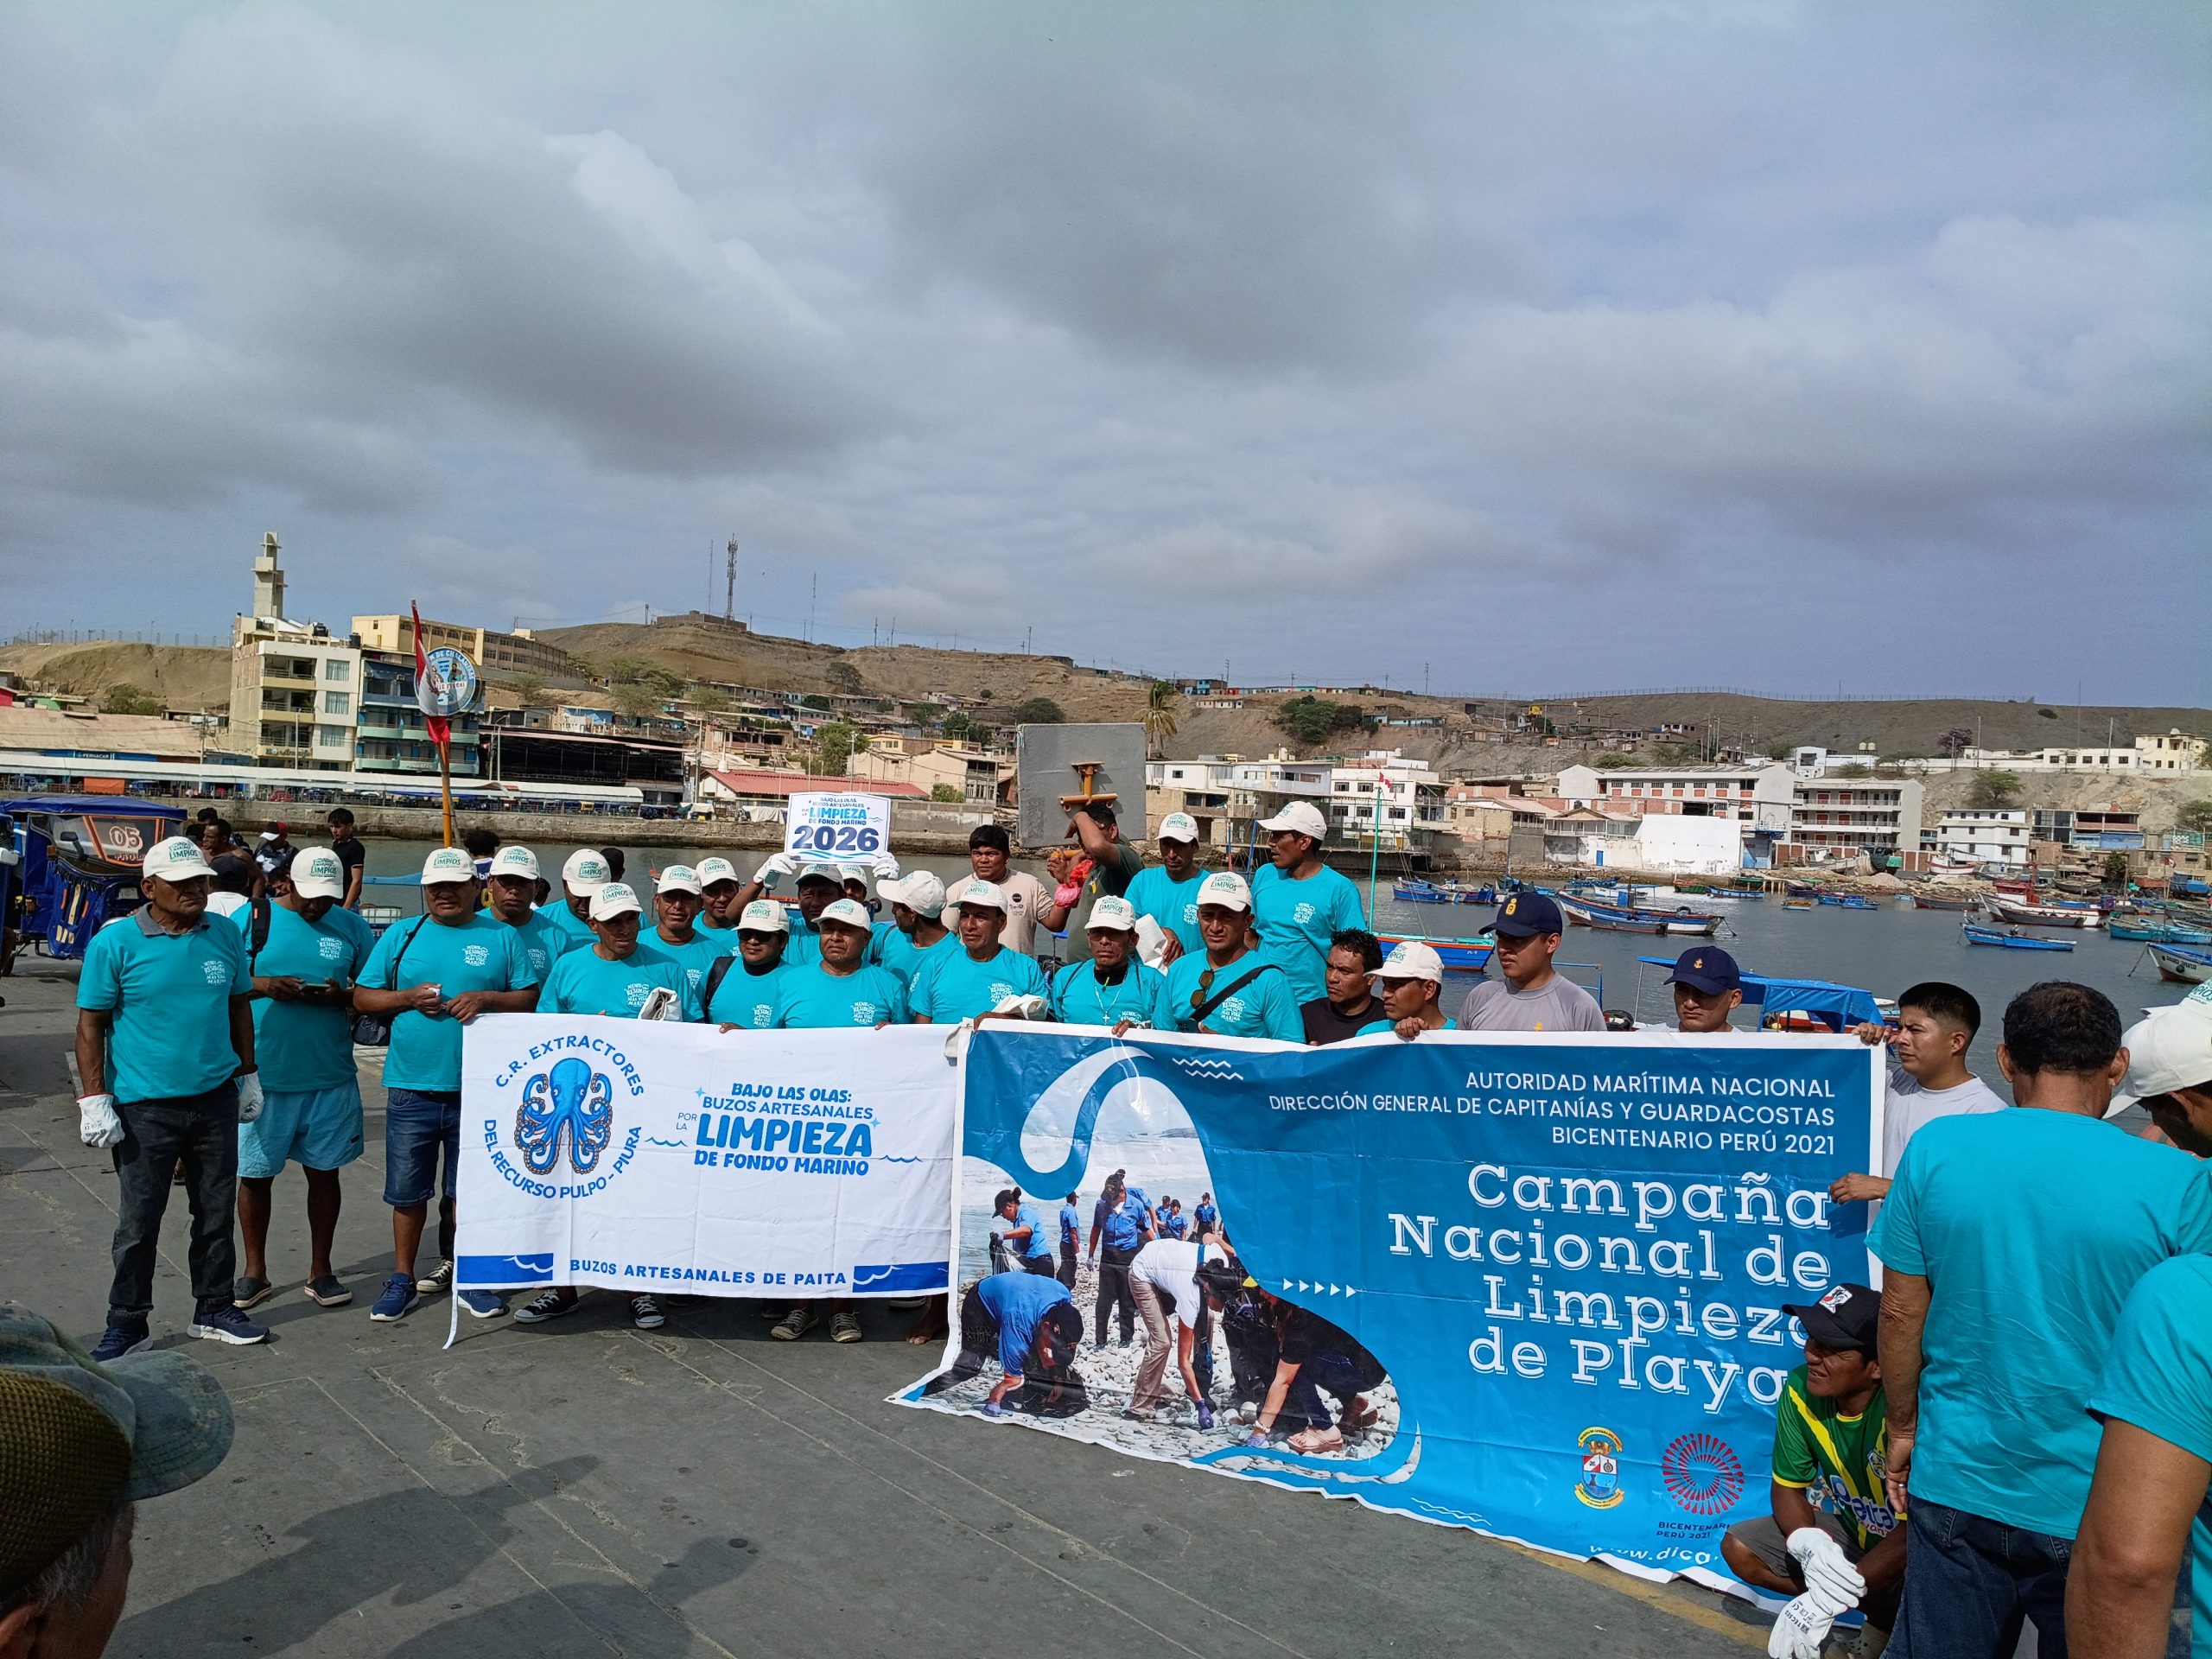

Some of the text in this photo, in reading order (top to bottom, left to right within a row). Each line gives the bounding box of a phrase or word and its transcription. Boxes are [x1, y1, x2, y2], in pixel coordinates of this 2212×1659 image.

[809, 807, 868, 820] LIMPIEZA
[109, 826, 143, 850] 05
[791, 824, 880, 852] 2026
[168, 849, 199, 860] LIMPIOS
[495, 1035, 645, 1096] C.R. EXTRACTORES
[731, 1082, 852, 1103] BAJO LAS OLAS:
[1466, 1071, 1835, 1097] AUTORIDAD MARÍTIMA NACIONAL
[702, 1096, 874, 1121] BUZOS ARTESANALES
[1268, 1091, 1834, 1126] DIRECCIÓN GENERAL DE CAPITANÍAS Y GUARDACOSTAS
[484, 1119, 499, 1152] DEL
[677, 1122, 688, 1131] LA
[677, 1112, 873, 1158] POR LIMPIEZA
[613, 1126, 642, 1174] PIURA
[1552, 1127, 1834, 1155] BICENTENARIO PERÚ 2021
[490, 1151, 556, 1199] RECURSO
[694, 1149, 869, 1176] DE FONDO MARINO
[560, 1177, 607, 1199] PULPO
[1467, 1164, 1831, 1232] Campaña
[1388, 1212, 1831, 1290] Nacional de
[569, 1259, 847, 1286] BUZOS ARTESANALES DE PAITA
[1468, 1326, 1789, 1414] de Playa
[1656, 1530, 1686, 1539] PERÚ
[1658, 1521, 1731, 1532] BICENTENARI
